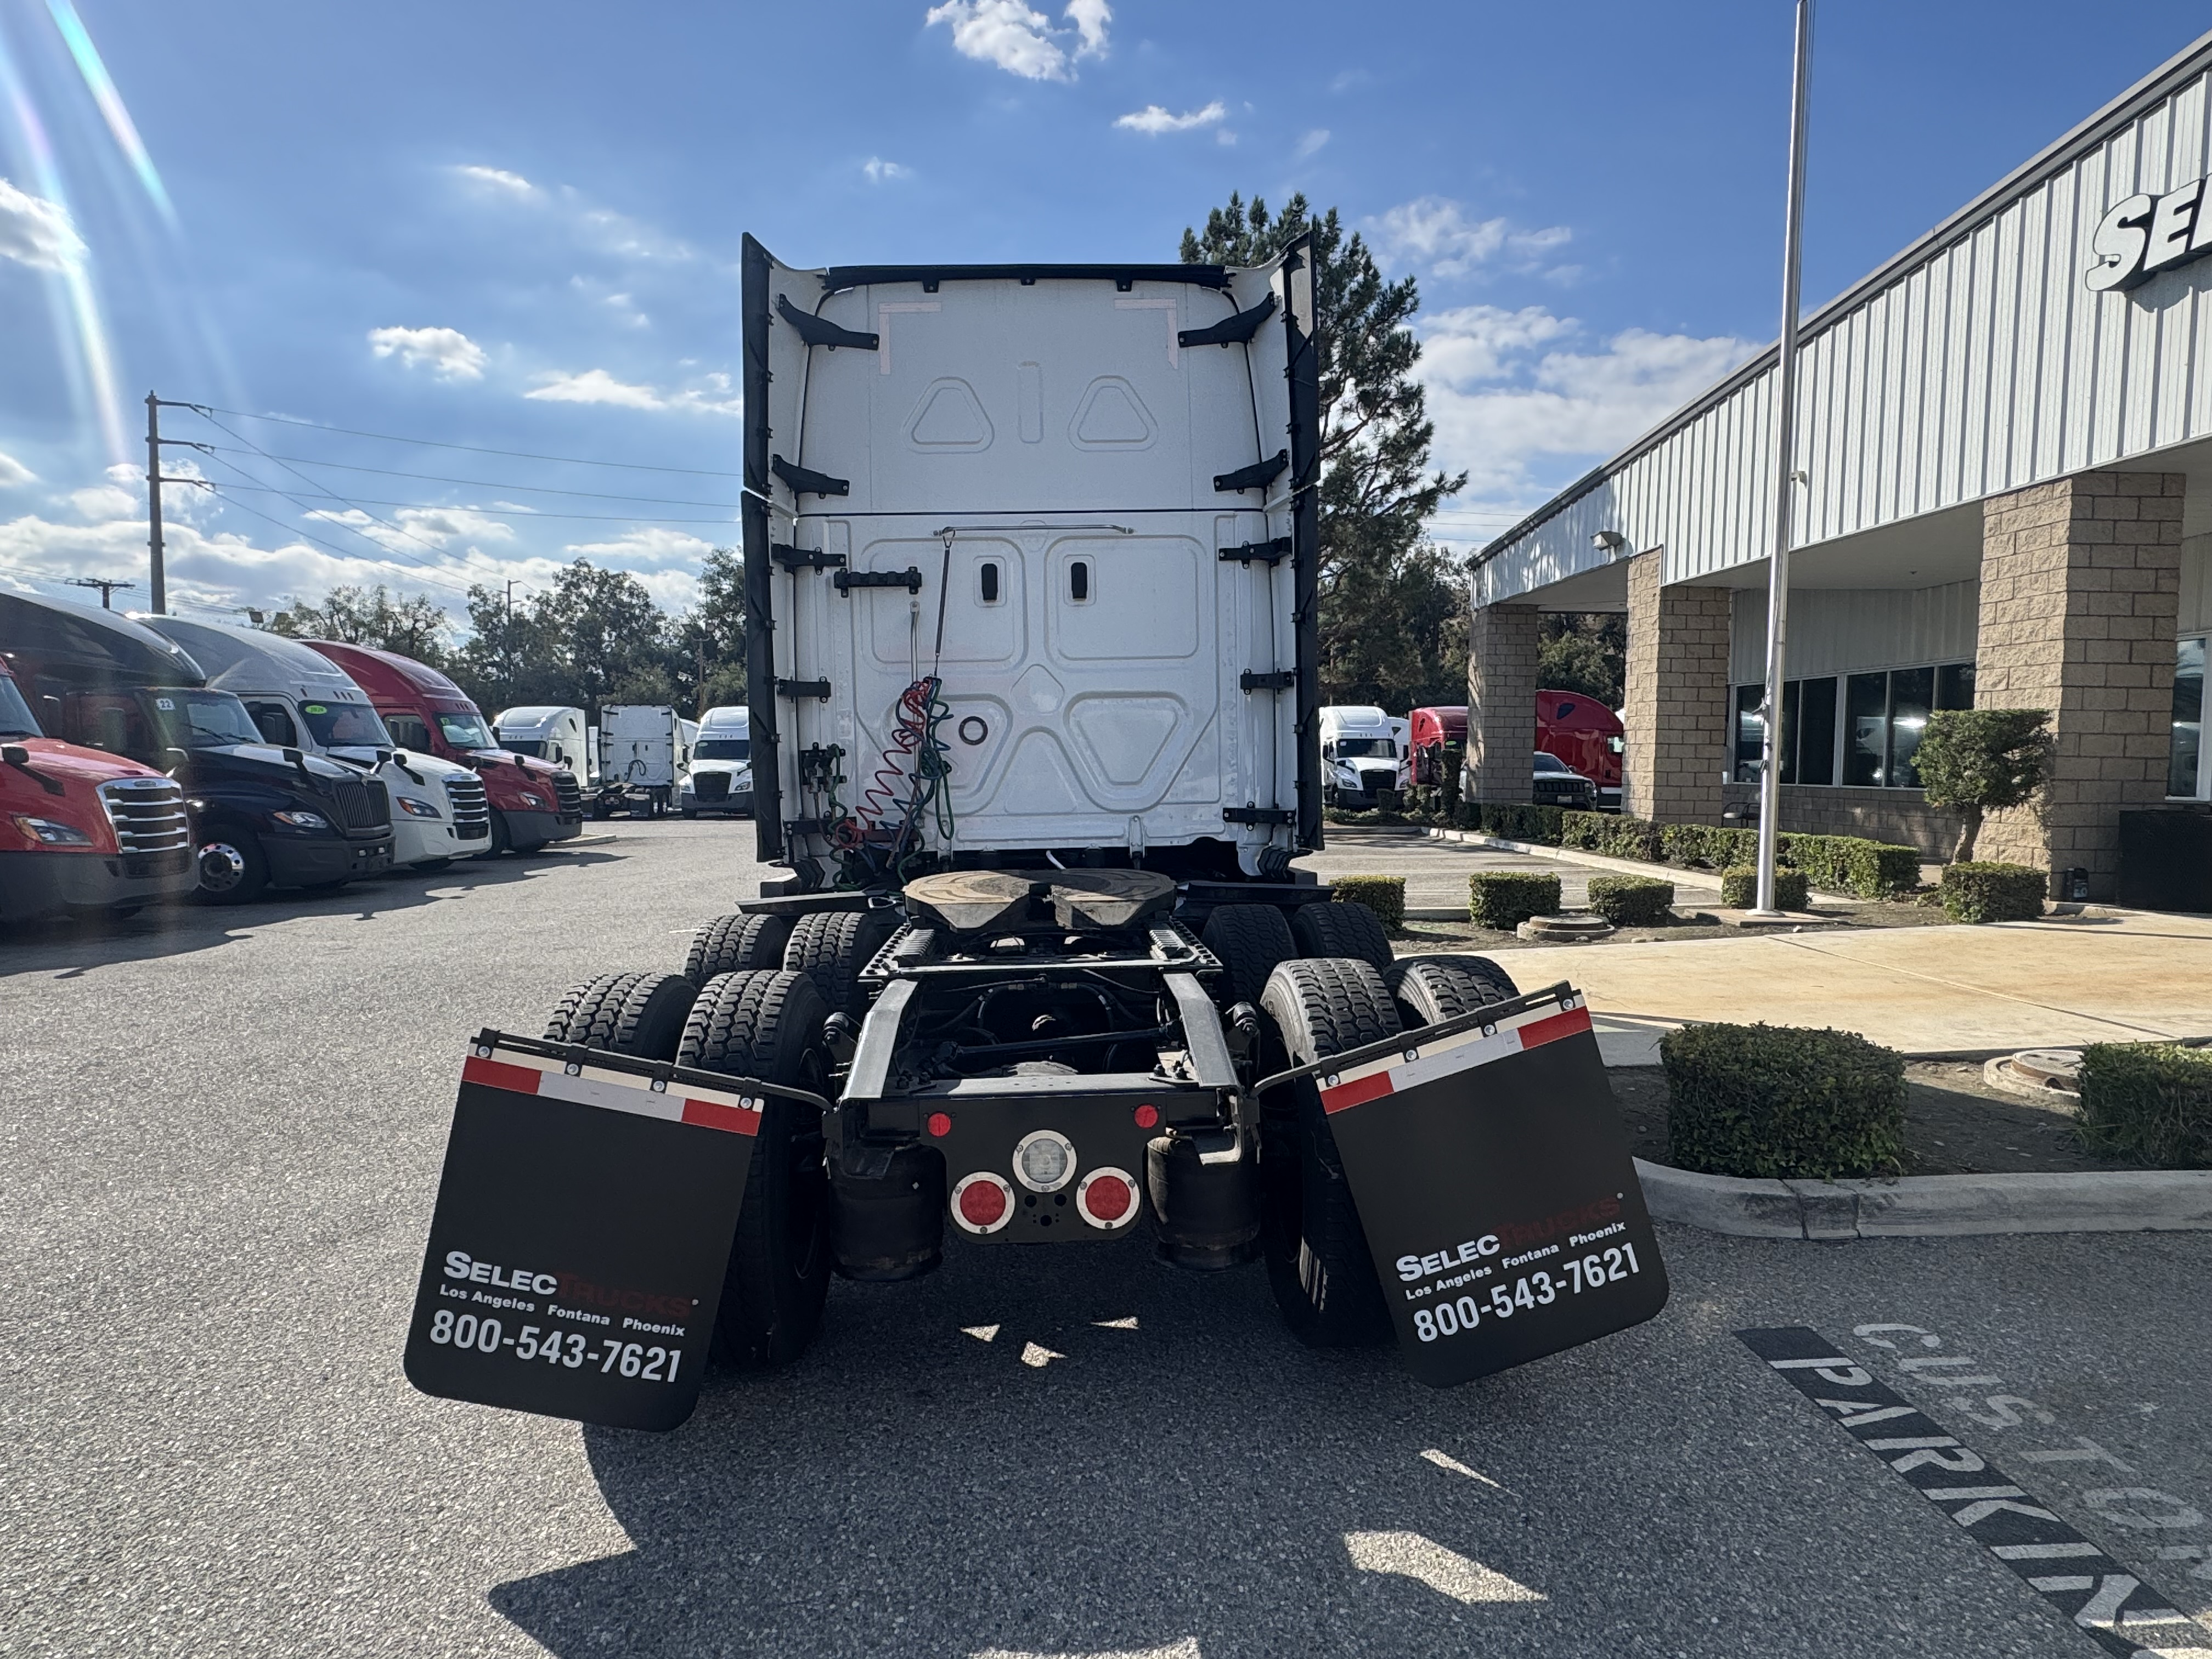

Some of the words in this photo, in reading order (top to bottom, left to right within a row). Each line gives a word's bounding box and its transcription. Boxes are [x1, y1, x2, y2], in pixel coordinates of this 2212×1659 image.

[1406, 1285, 1432, 1300] Los
[1436, 1266, 1492, 1291] Angeles
[1502, 1244, 1560, 1269] Fontana
[1569, 1222, 1626, 1247] Phoenix
[1414, 1242, 1640, 1342] 800-543-7621
[430, 1309, 682, 1383] 800-543-7621
[440, 1284, 467, 1300] Los
[471, 1290, 535, 1312] Angeles
[548, 1305, 610, 1325] Fontana
[622, 1318, 686, 1337] Phoenix
[1768, 1357, 2212, 1659] PARKIN
